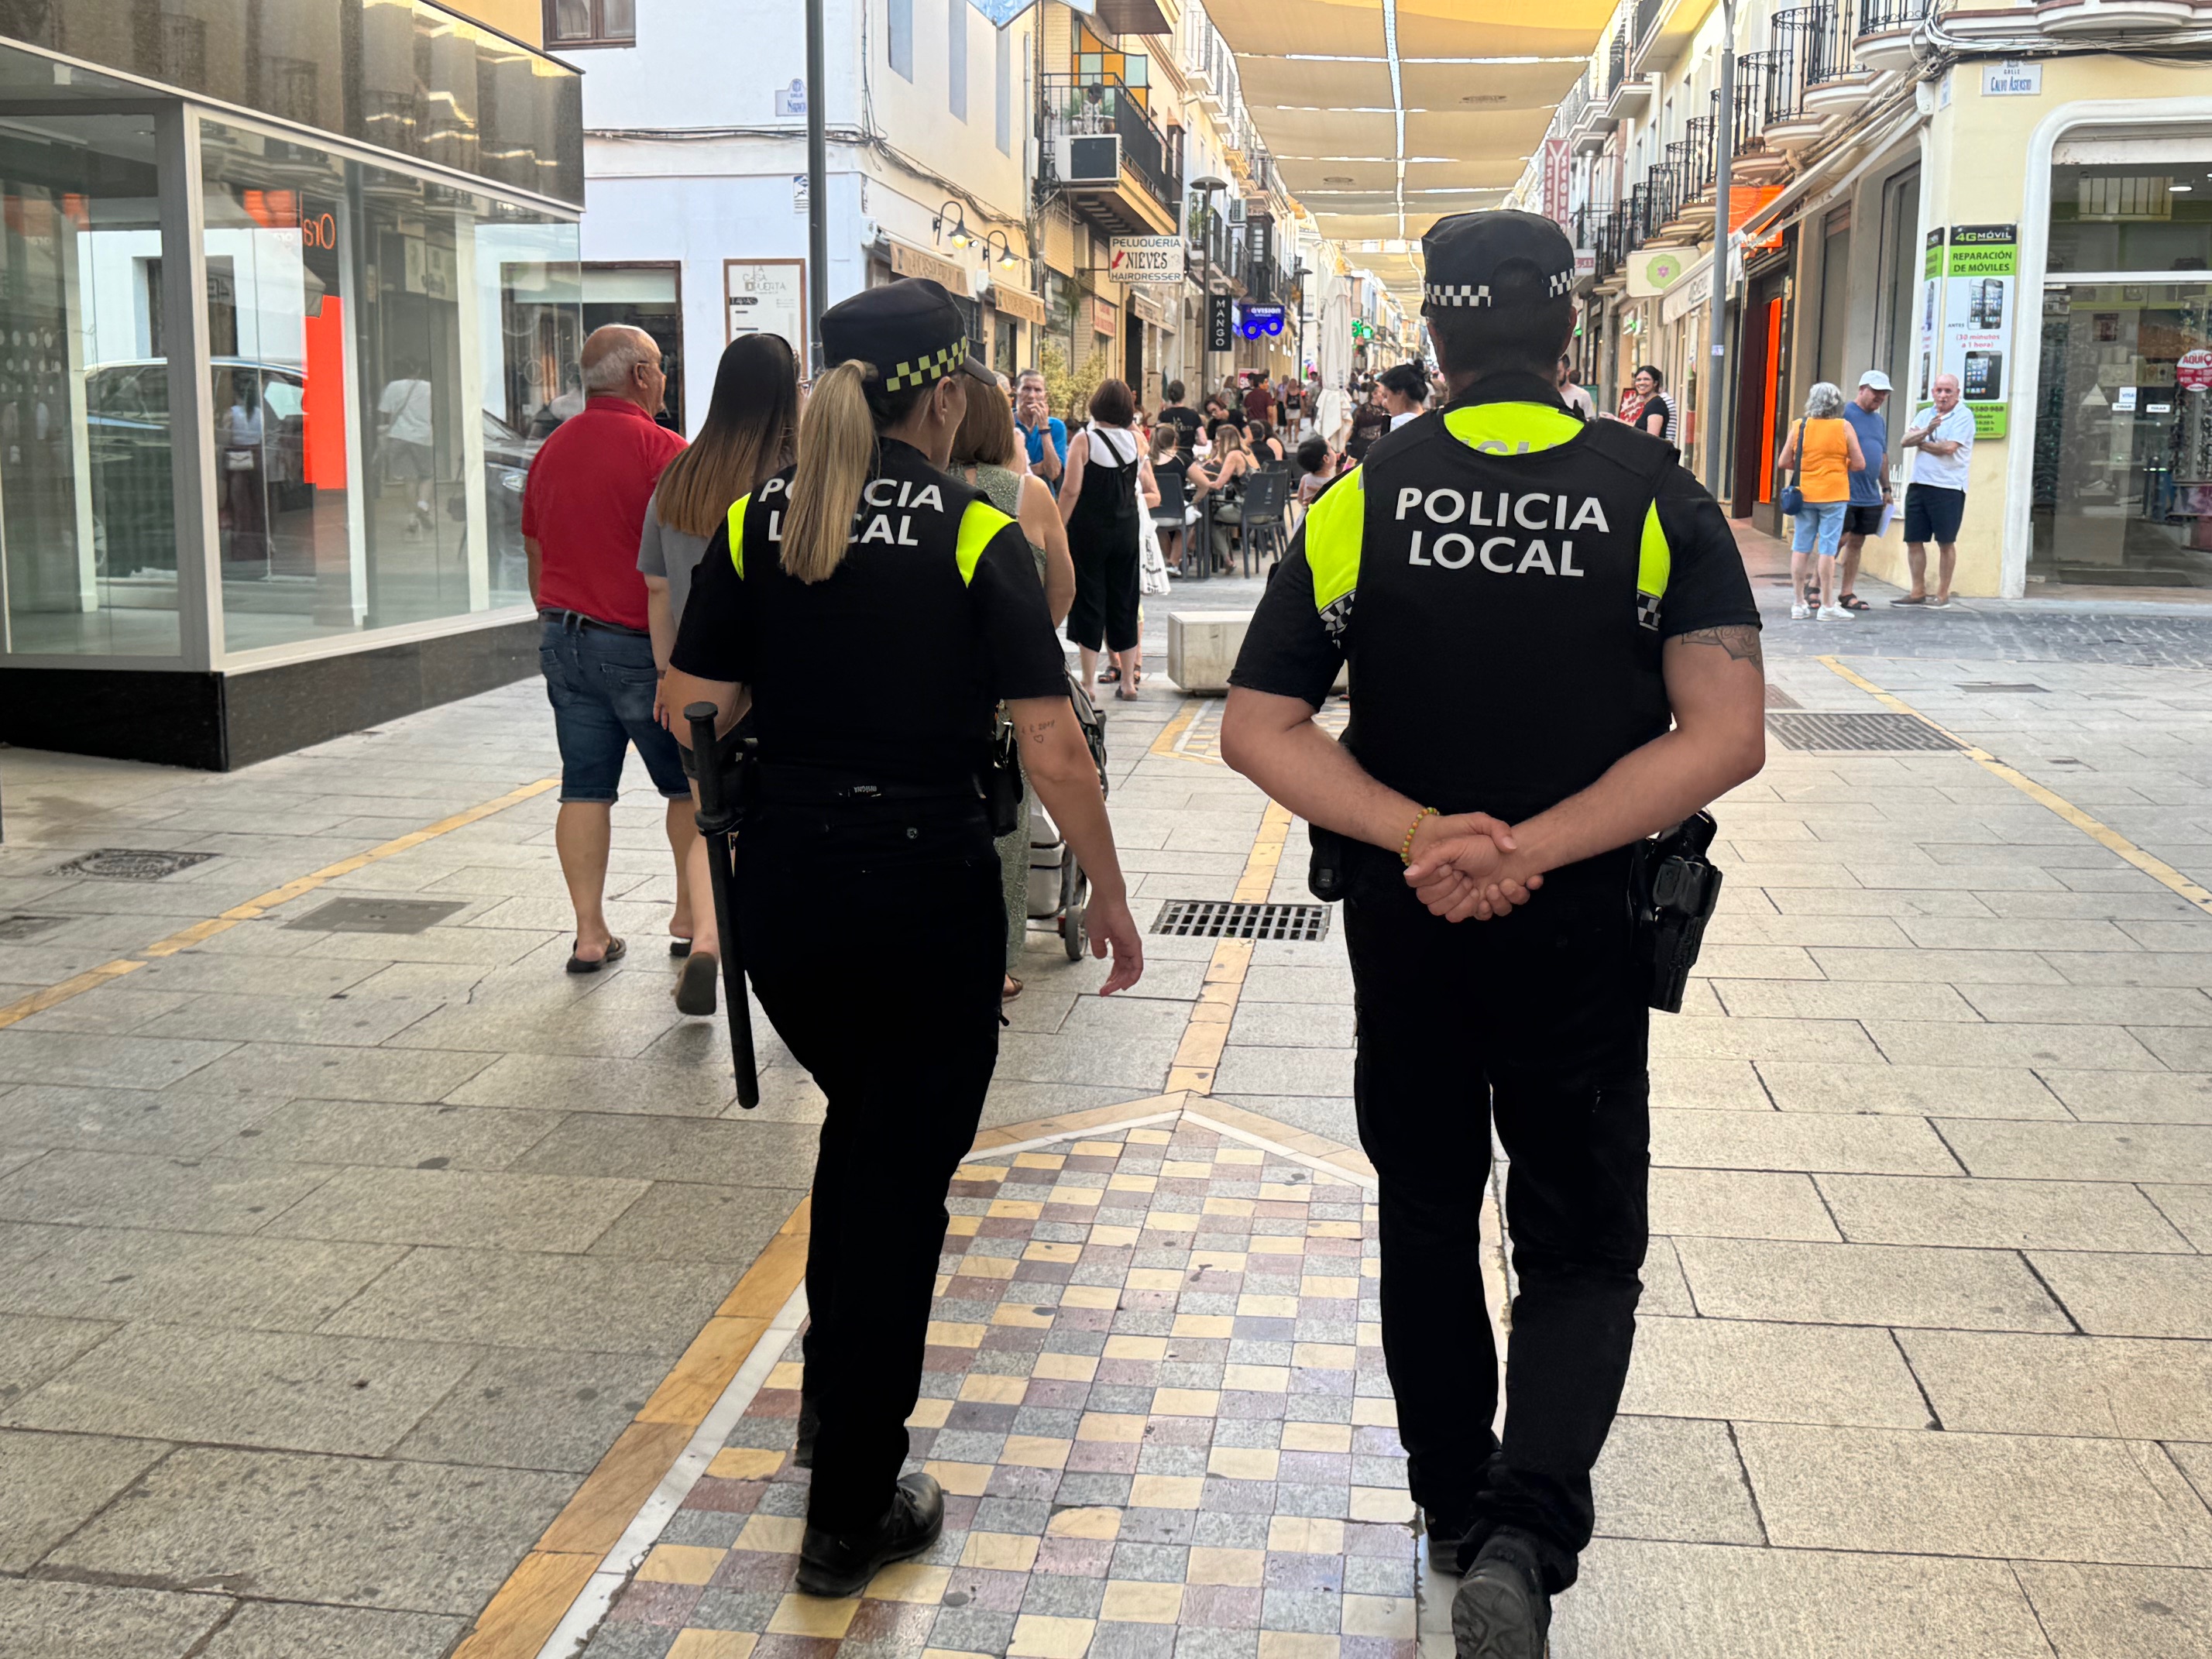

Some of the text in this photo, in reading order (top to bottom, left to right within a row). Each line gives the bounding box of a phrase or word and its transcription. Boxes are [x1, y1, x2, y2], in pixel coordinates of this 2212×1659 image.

[1990, 77, 2008, 91] CALVO
[1112, 239, 1181, 248] PELUQUERIA
[1953, 251, 2012, 261] REPARACIÓN
[1125, 252, 1168, 269] NIEVES
[1969, 262, 2011, 272] MÓVILES
[1215, 299, 1226, 347] MANGO
[758, 478, 944, 513] PCIA
[1396, 488, 1610, 533] POLICIA
[768, 510, 919, 546] LAL
[1409, 531, 1584, 577] LOCAL
